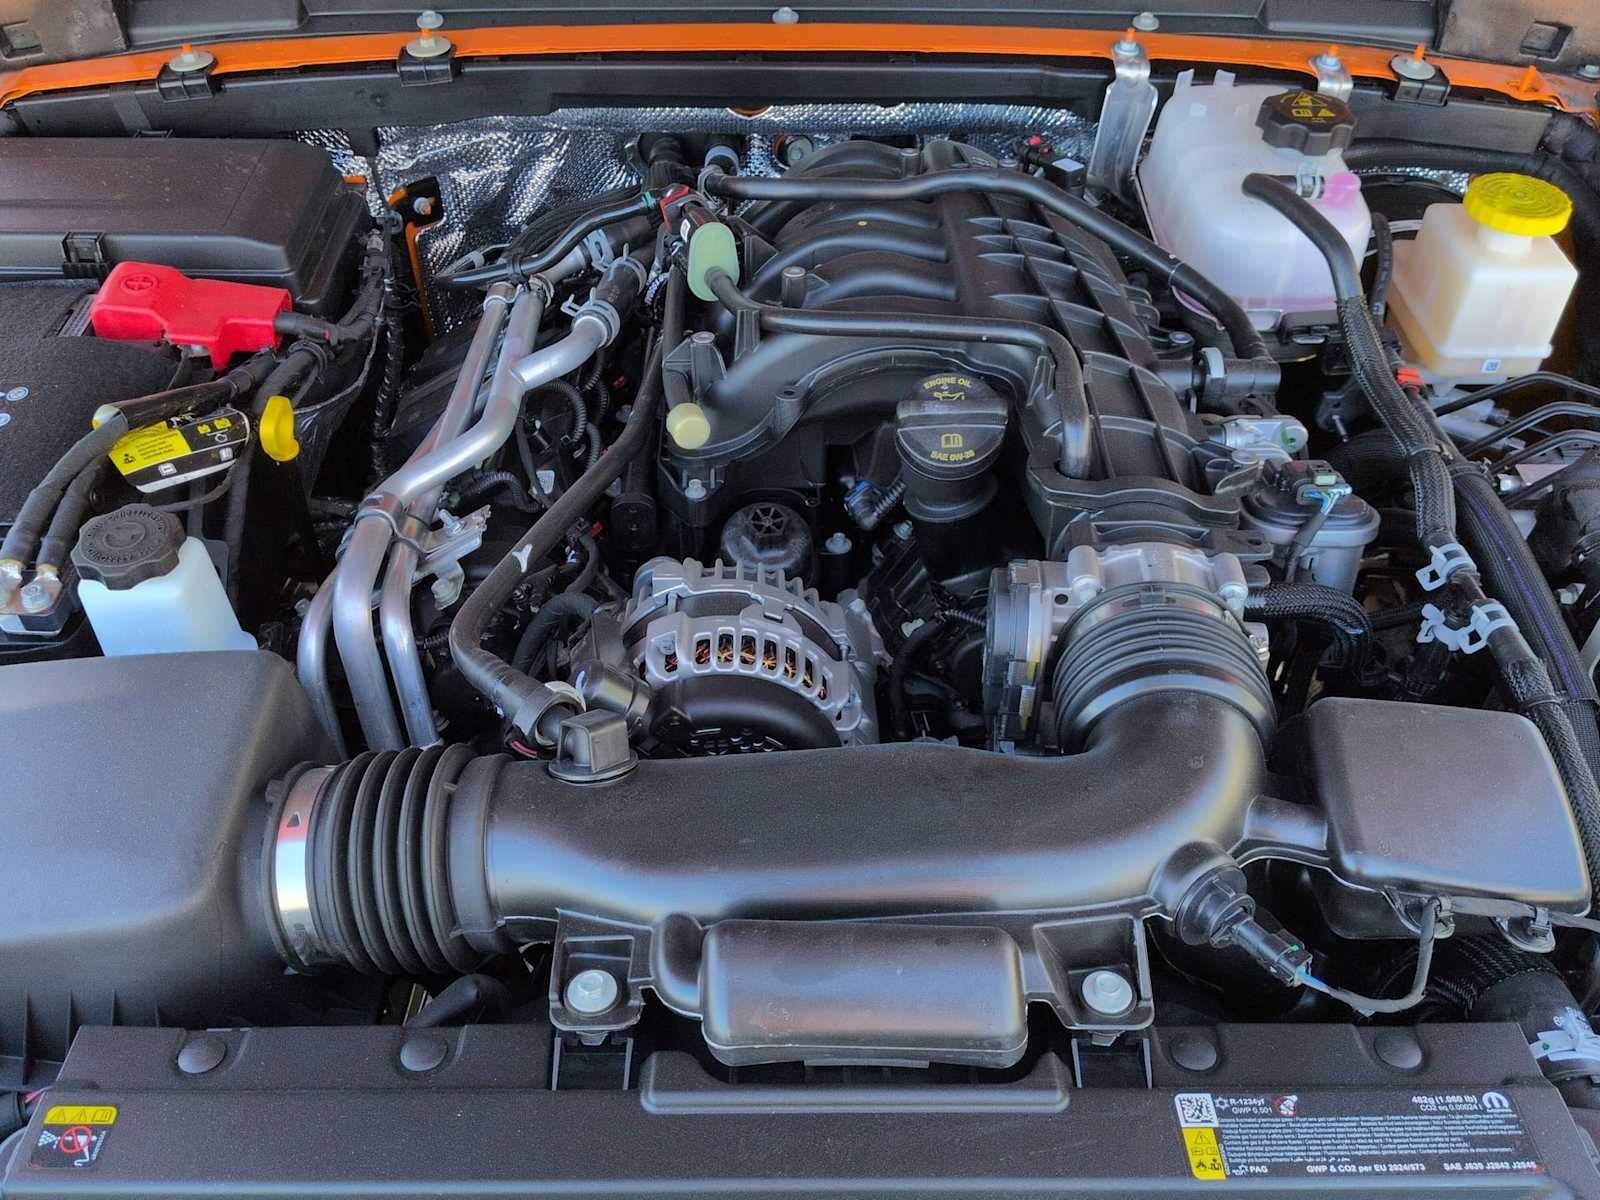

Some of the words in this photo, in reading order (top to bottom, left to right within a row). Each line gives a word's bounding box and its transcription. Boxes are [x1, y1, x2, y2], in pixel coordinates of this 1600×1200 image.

[923, 376, 957, 390] ENGINE
[958, 377, 972, 389] OIL
[1250, 1165, 1268, 1173] PAG
[1306, 1165, 1327, 1173] GWP
[1329, 1164, 1336, 1172] &
[1338, 1164, 1357, 1173] CO2
[1358, 1165, 1372, 1173] per
[1374, 1163, 1387, 1172] EU
[1443, 1162, 1462, 1171] SAE
